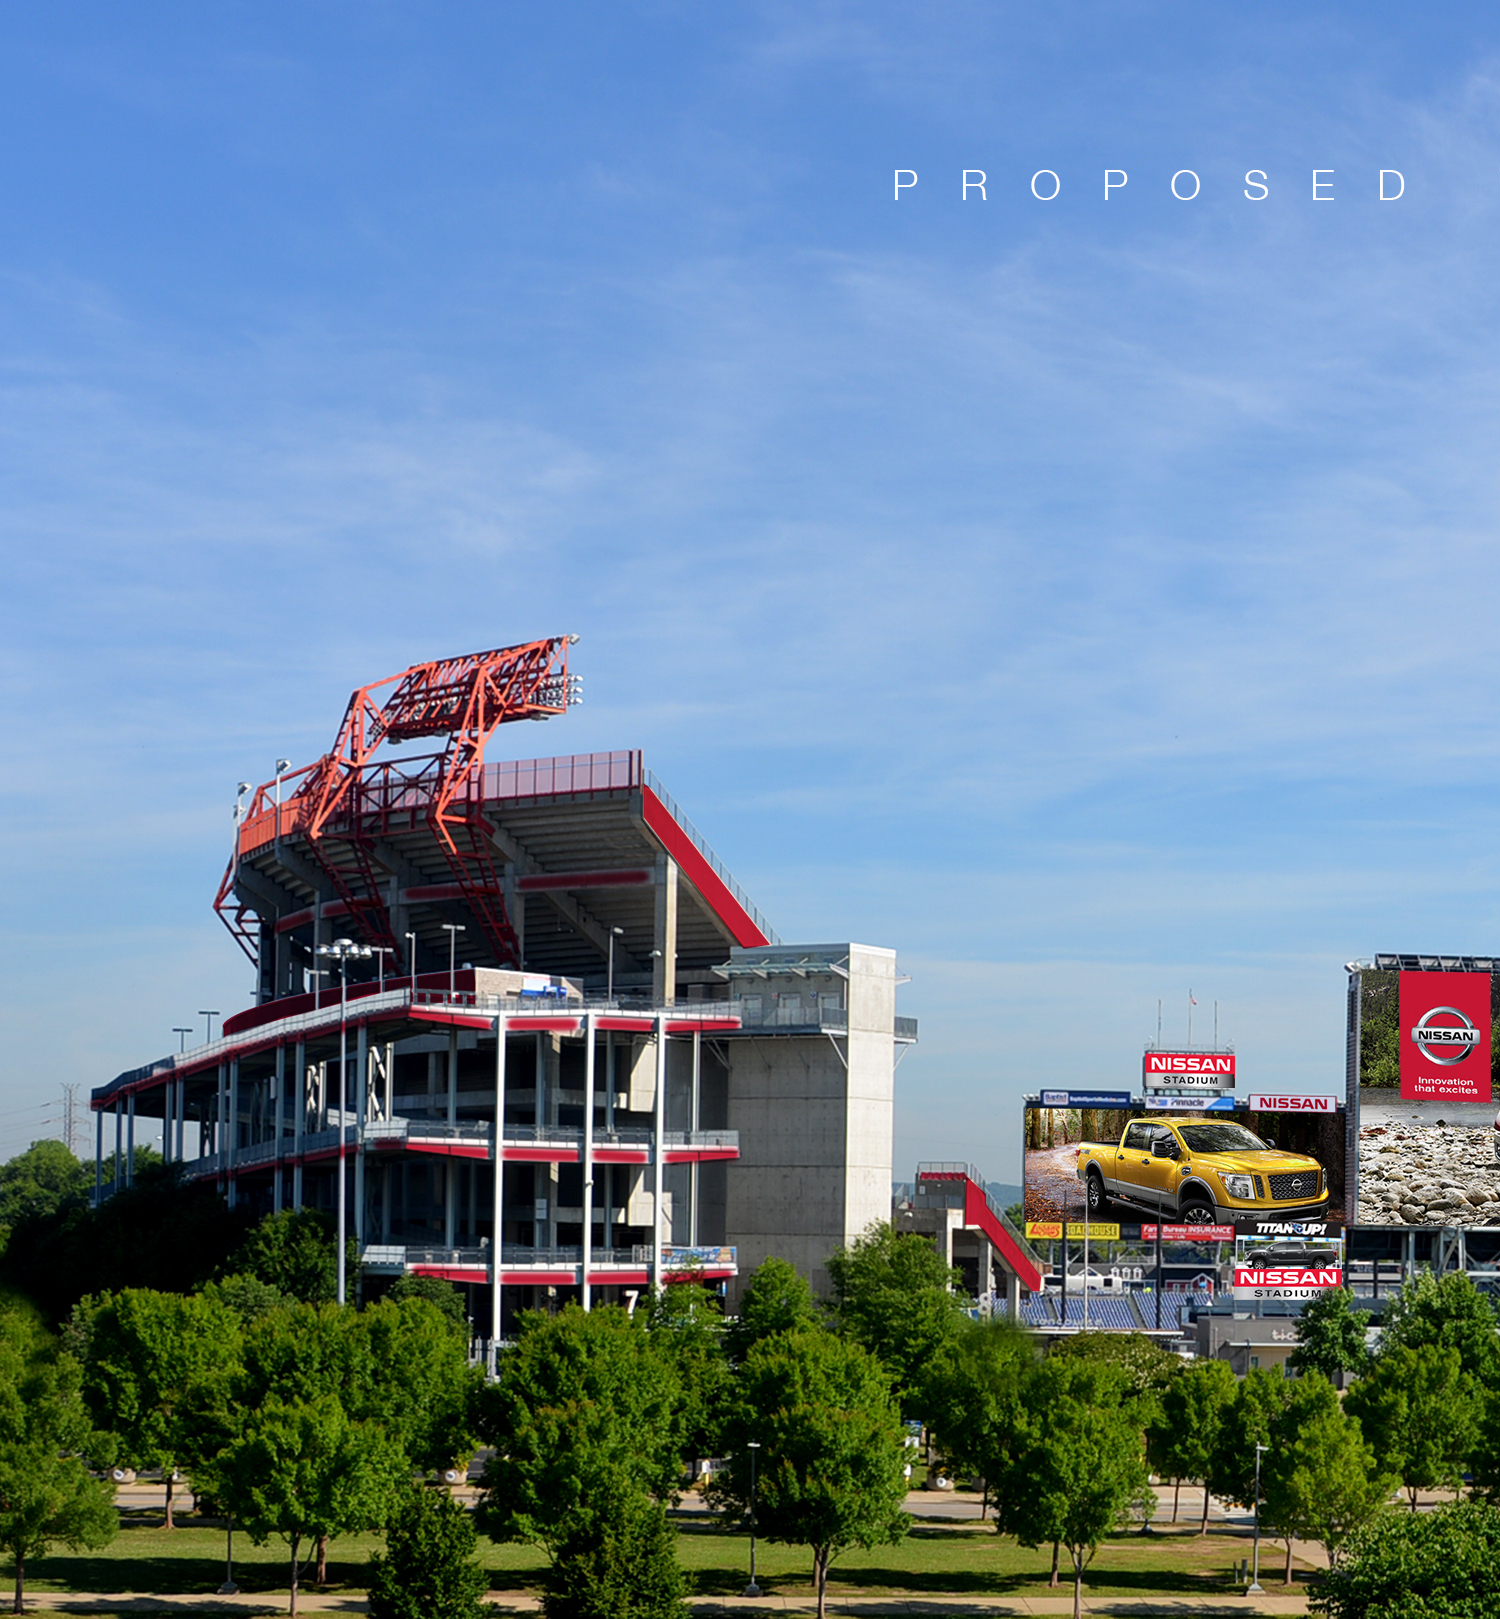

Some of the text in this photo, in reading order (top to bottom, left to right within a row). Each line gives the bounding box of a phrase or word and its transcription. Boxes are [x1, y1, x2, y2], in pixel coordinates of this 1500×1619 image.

[1418, 1030, 1474, 1042] NISSAN
[1151, 1057, 1231, 1072] NISSAN
[1163, 1075, 1218, 1085] STADIUM
[1418, 1076, 1474, 1086] Innovation
[1414, 1084, 1478, 1095] that excites
[1259, 1097, 1328, 1110] NISSAN
[1162, 1225, 1187, 1233] Bureau
[1187, 1225, 1233, 1234] INSURANCE
[1256, 1222, 1328, 1236] TITAN UP!
[1240, 1271, 1337, 1285] NISSAN
[1254, 1289, 1322, 1298] STADIUM
[625, 1289, 640, 1319] 7
